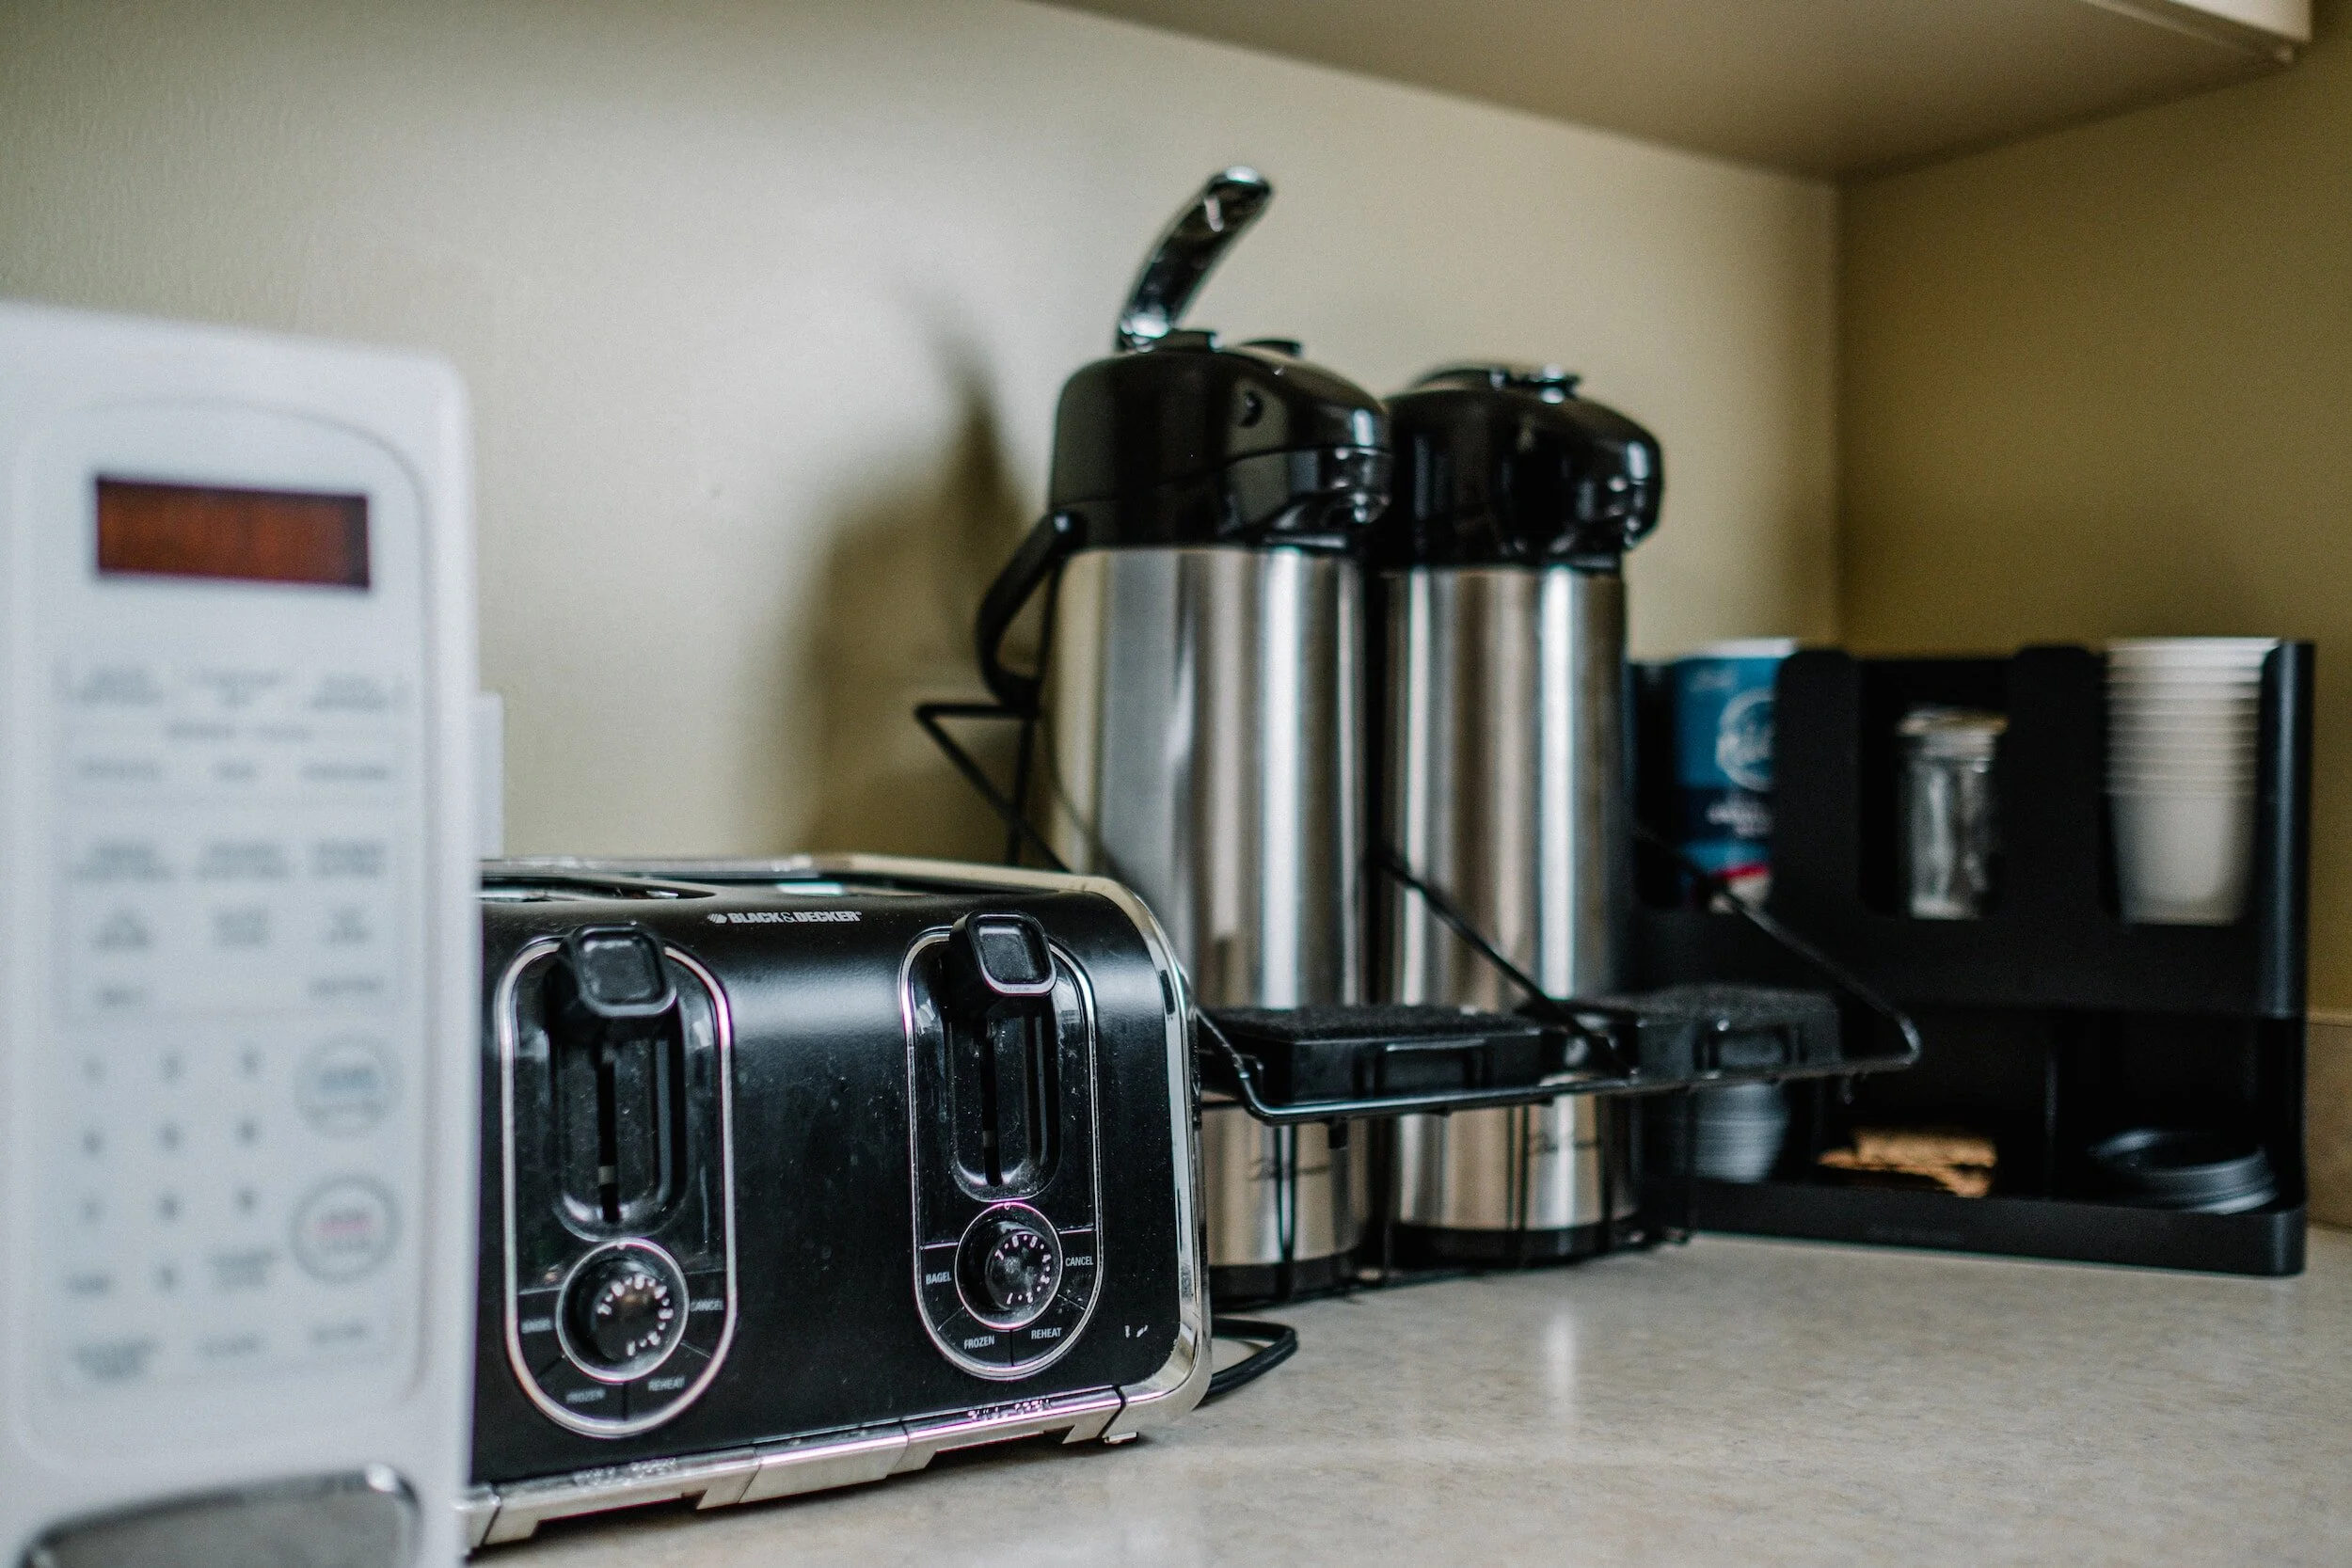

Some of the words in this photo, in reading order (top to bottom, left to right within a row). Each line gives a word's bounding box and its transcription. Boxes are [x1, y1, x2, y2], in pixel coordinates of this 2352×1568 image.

[994, 1249, 1004, 1260] 7
[1065, 1256, 1093, 1267] CANCEL
[925, 1272, 951, 1285] BAGEL
[1006, 1292, 1013, 1305] 1
[1031, 1327, 1062, 1339] REHEAT
[963, 1335, 995, 1350] FROZEN
